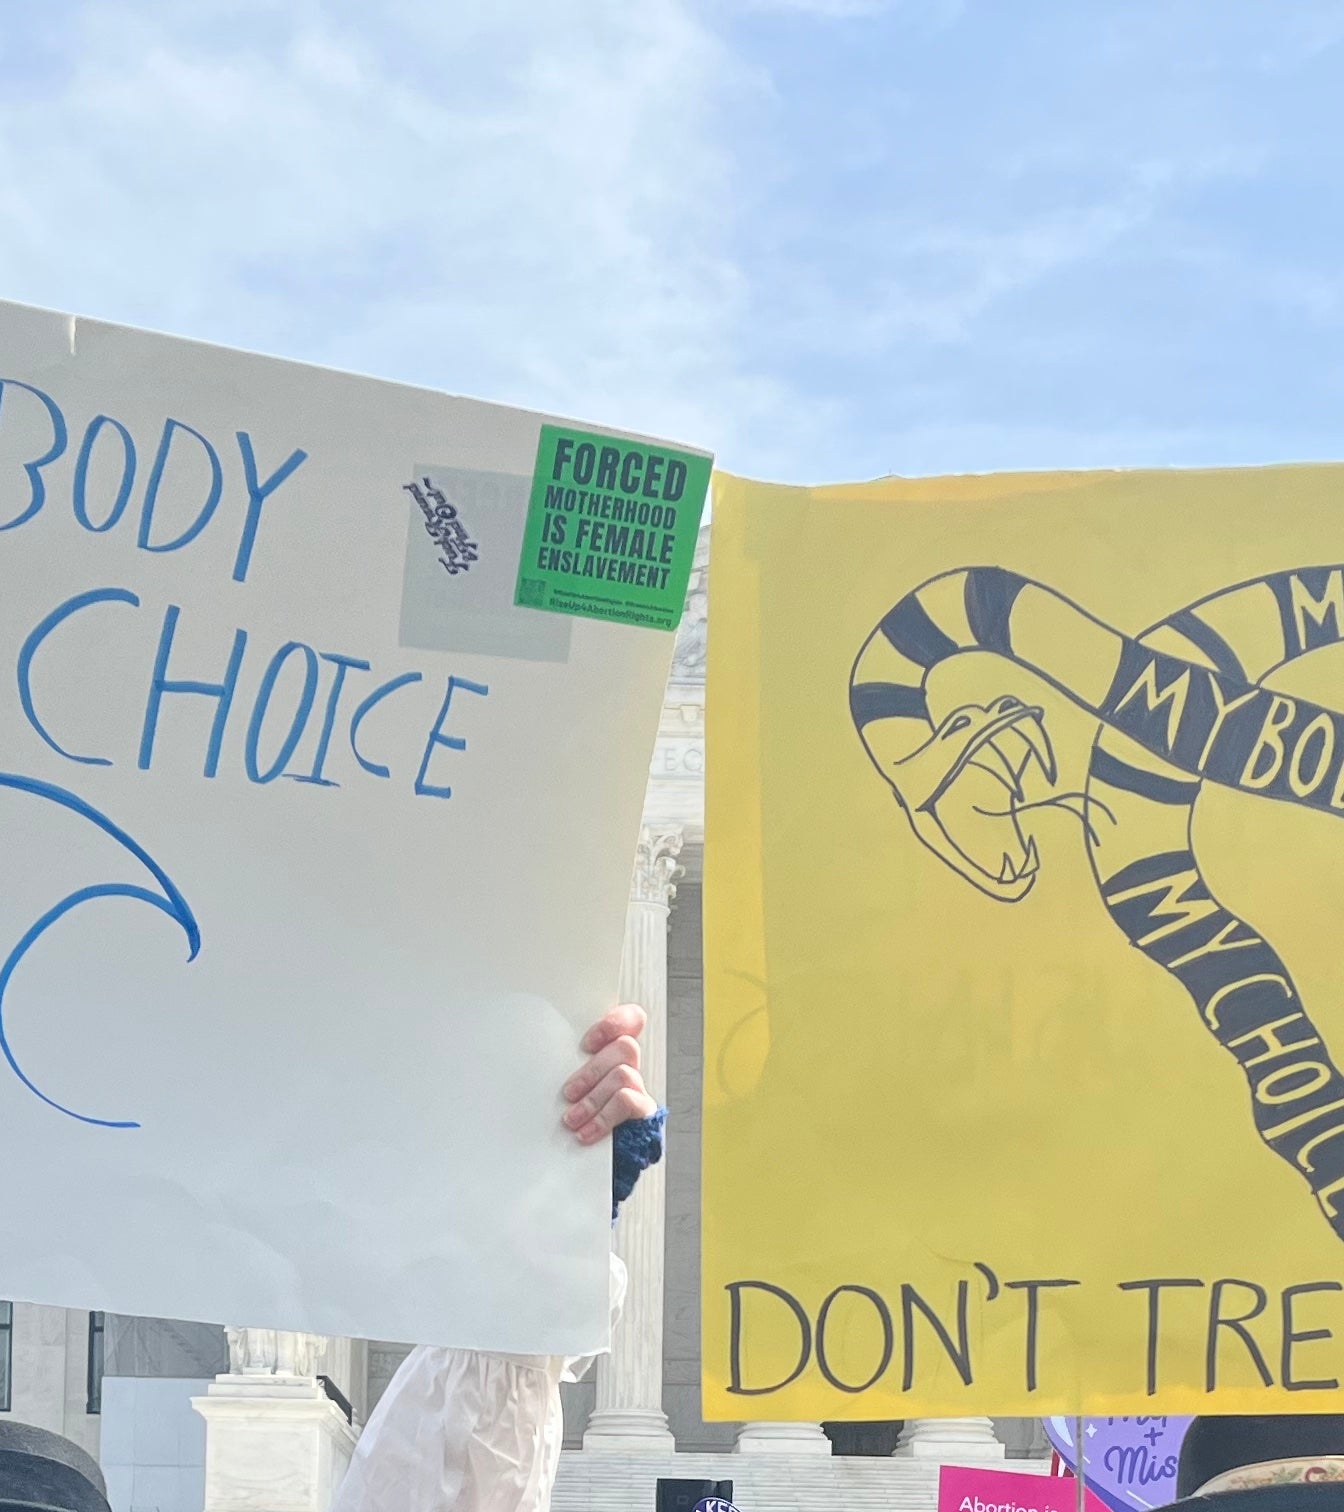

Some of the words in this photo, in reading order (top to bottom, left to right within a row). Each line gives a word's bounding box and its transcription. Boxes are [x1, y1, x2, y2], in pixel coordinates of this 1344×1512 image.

[552, 438, 687, 502] FORCED
[542, 513, 566, 544] IS
[575, 518, 675, 564] FEMALE
[544, 485, 677, 529] MOTHERHOOD
[537, 547, 671, 590] ENSLAVEMENT
[17, 587, 488, 798] CHOICE
[1112, 659, 1258, 771] MY
[1107, 869, 1261, 969] MY
[724, 1261, 1080, 1397] DON'T
[1104, 1445, 1178, 1486] Mis
